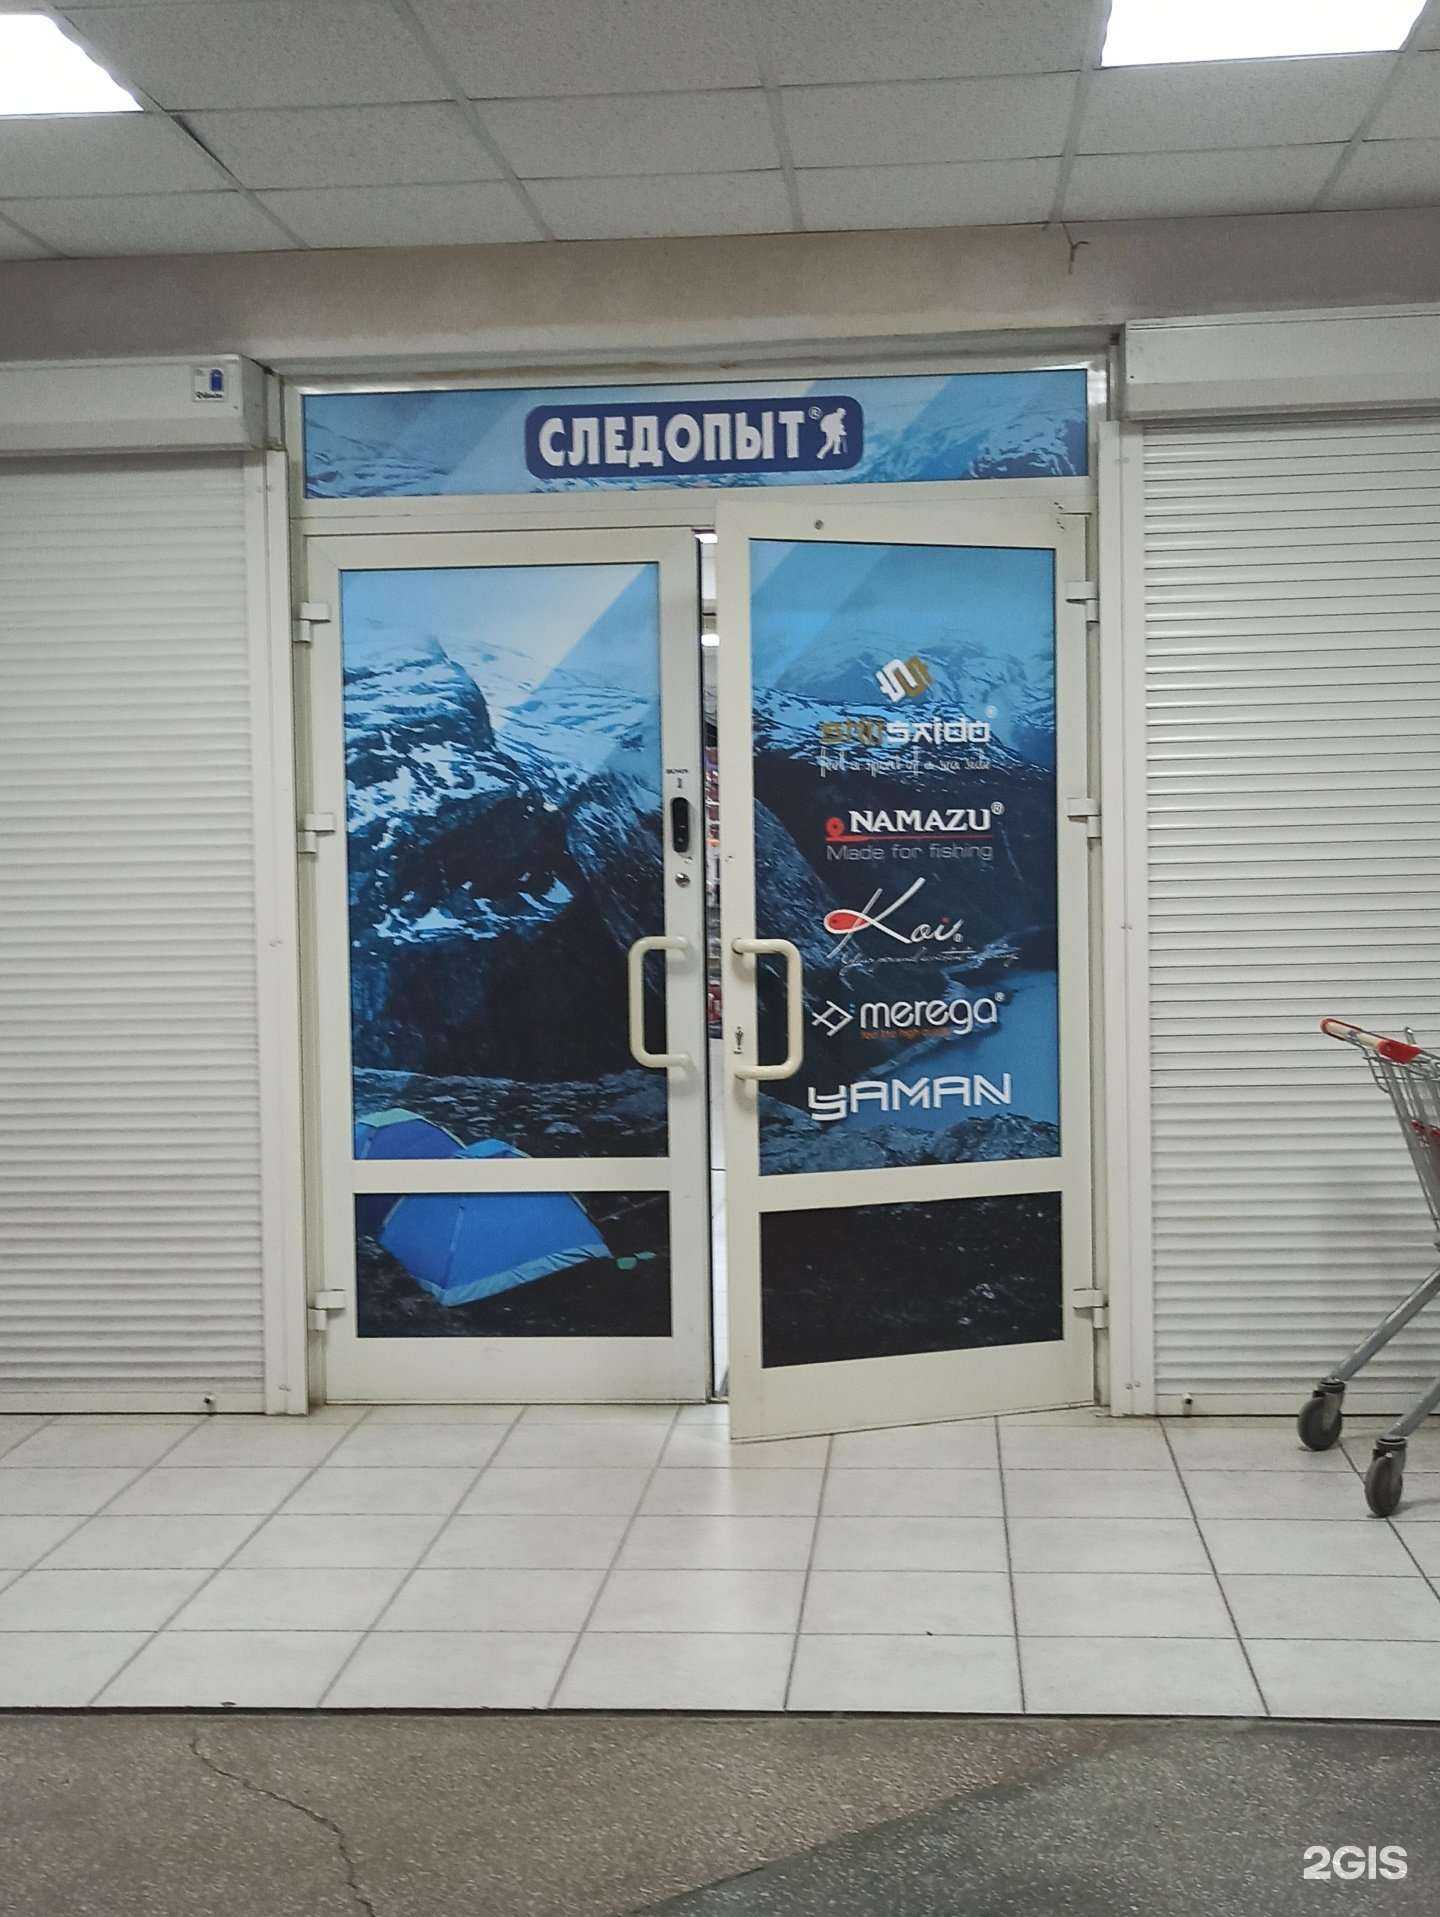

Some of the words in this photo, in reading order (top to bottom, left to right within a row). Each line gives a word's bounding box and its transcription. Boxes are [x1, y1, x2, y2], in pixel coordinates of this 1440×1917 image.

[539, 411, 804, 467] СЛЕДОПЫТ
[848, 808, 992, 833] NAMAZU
[826, 844, 885, 861] Made
[892, 843, 926, 860] for
[929, 842, 993, 862] fishing
[860, 998, 997, 1034] merega
